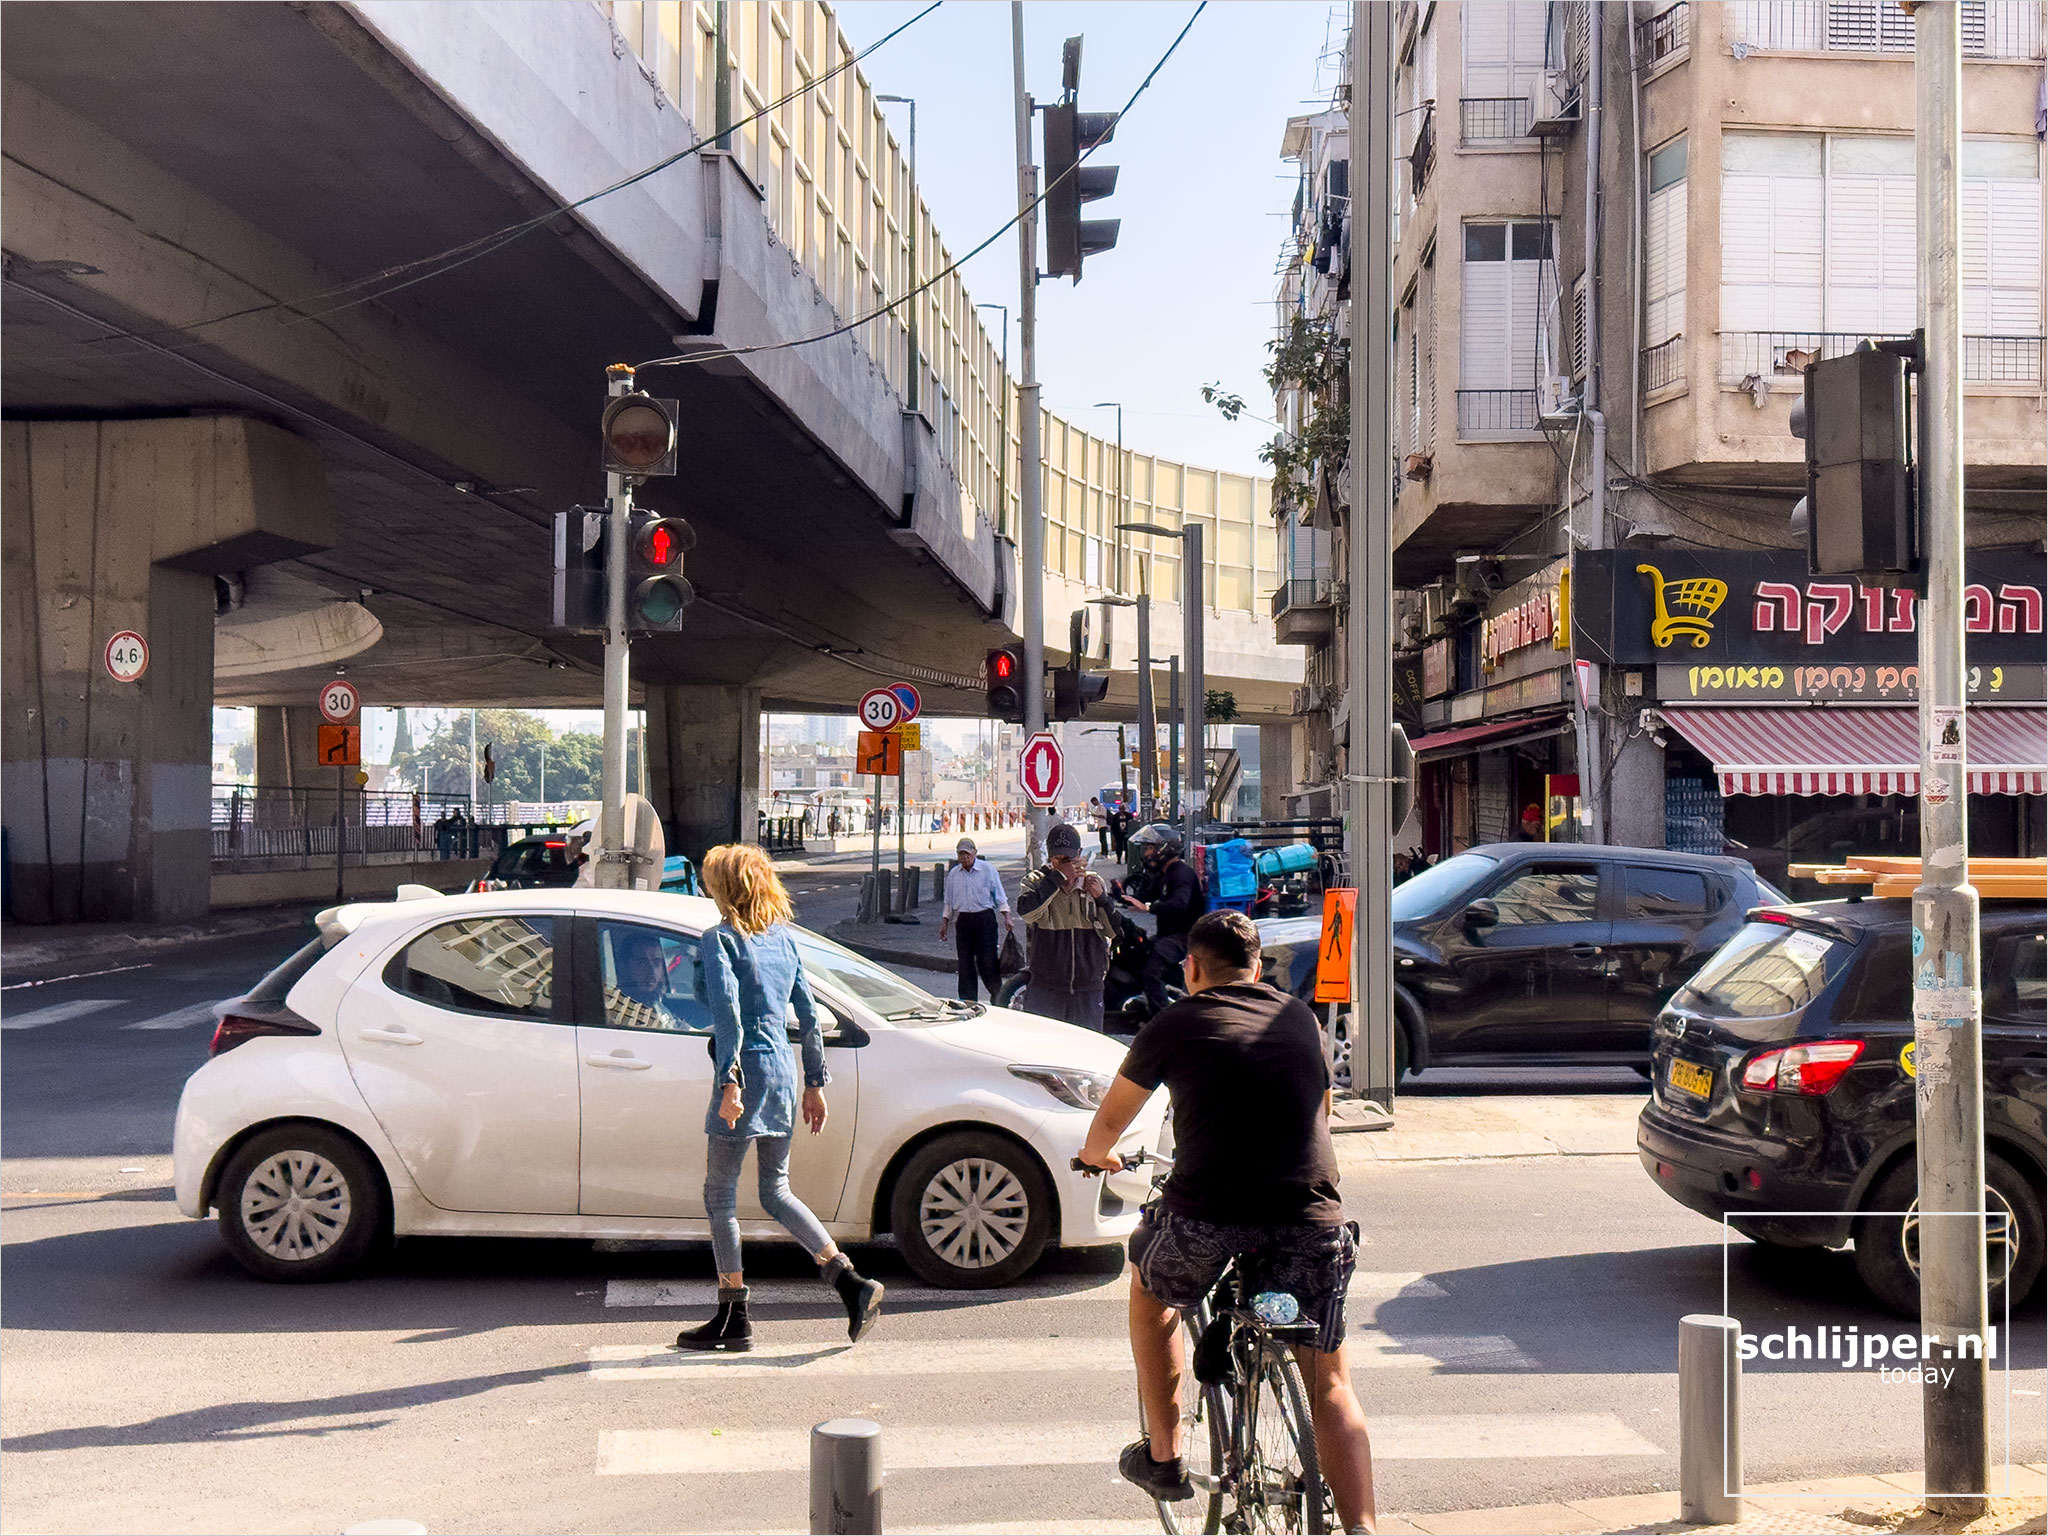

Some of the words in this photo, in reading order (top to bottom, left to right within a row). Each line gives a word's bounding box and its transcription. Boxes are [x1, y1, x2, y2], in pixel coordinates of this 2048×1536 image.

[115, 648, 138, 664] 4.6
[1689, 666, 1785, 697] מאומן
[329, 693, 350, 711] 30
[868, 701, 893, 720] 30
